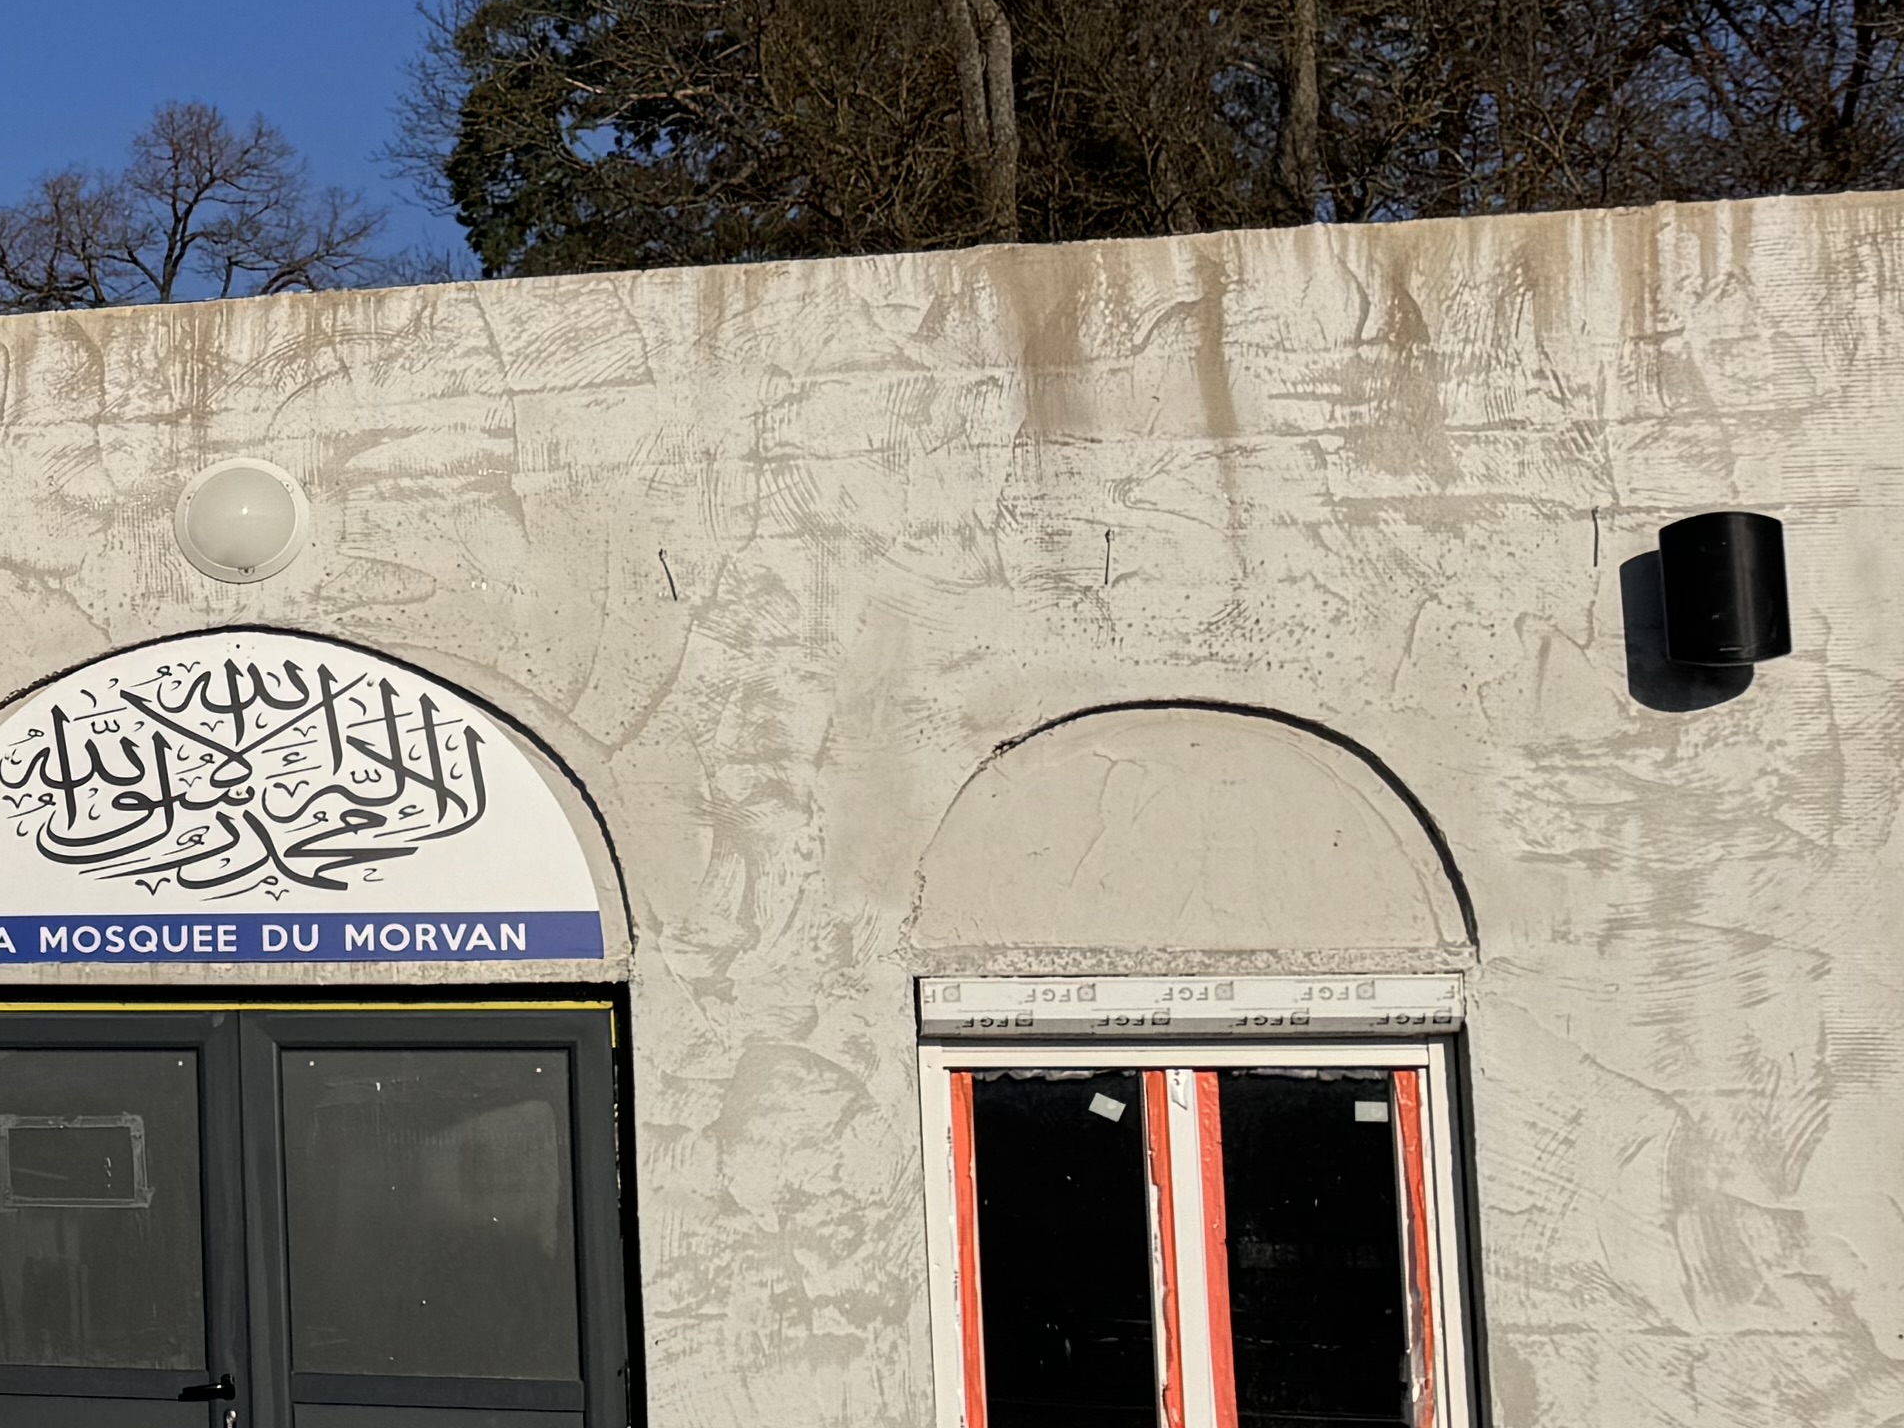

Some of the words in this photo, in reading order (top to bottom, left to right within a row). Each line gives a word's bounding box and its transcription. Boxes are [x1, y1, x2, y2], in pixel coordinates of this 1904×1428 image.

[39, 925, 237, 954] MOSQUEE
[262, 923, 319, 953] DU
[344, 922, 526, 952] MORVAN
